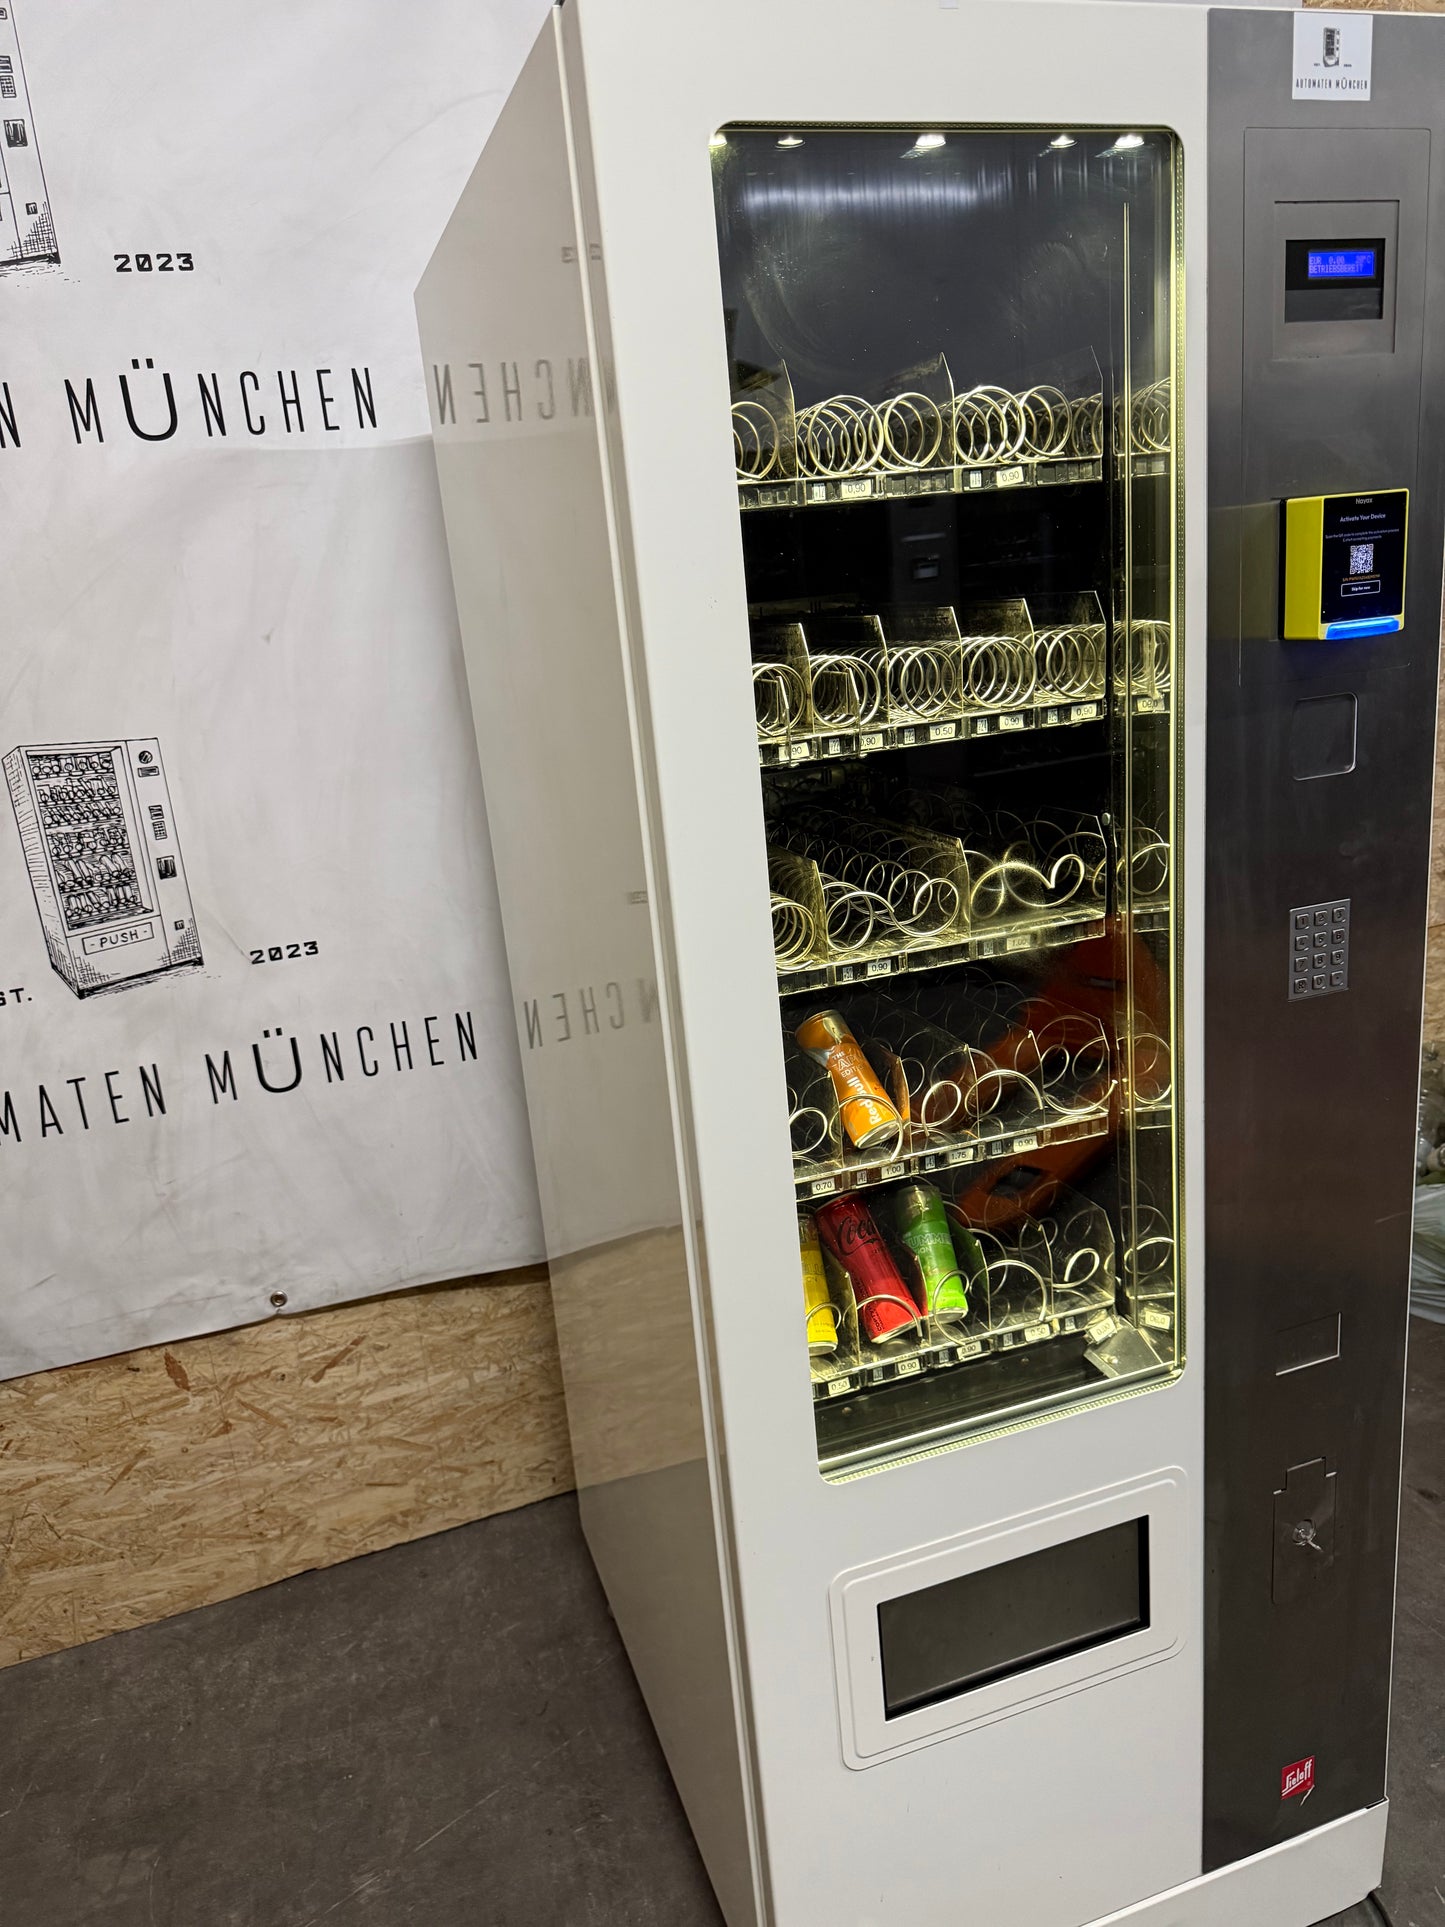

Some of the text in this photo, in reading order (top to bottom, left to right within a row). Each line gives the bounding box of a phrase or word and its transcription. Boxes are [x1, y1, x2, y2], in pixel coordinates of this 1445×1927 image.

[1296, 77, 1368, 90] AUTOMATEN MÜNCHEN
[113, 252, 194, 273] 2023
[64, 358, 378, 444] MÜNCHEN
[100, 929, 139, 948] PUSH
[250, 940, 319, 965] 2023
[0, 1011, 479, 1146] MATEN MÜNCHEN
[952, 1152, 966, 1160] 1.75
[886, 1166, 902, 1175] 1.00
[816, 1181, 832, 1191] 0.70
